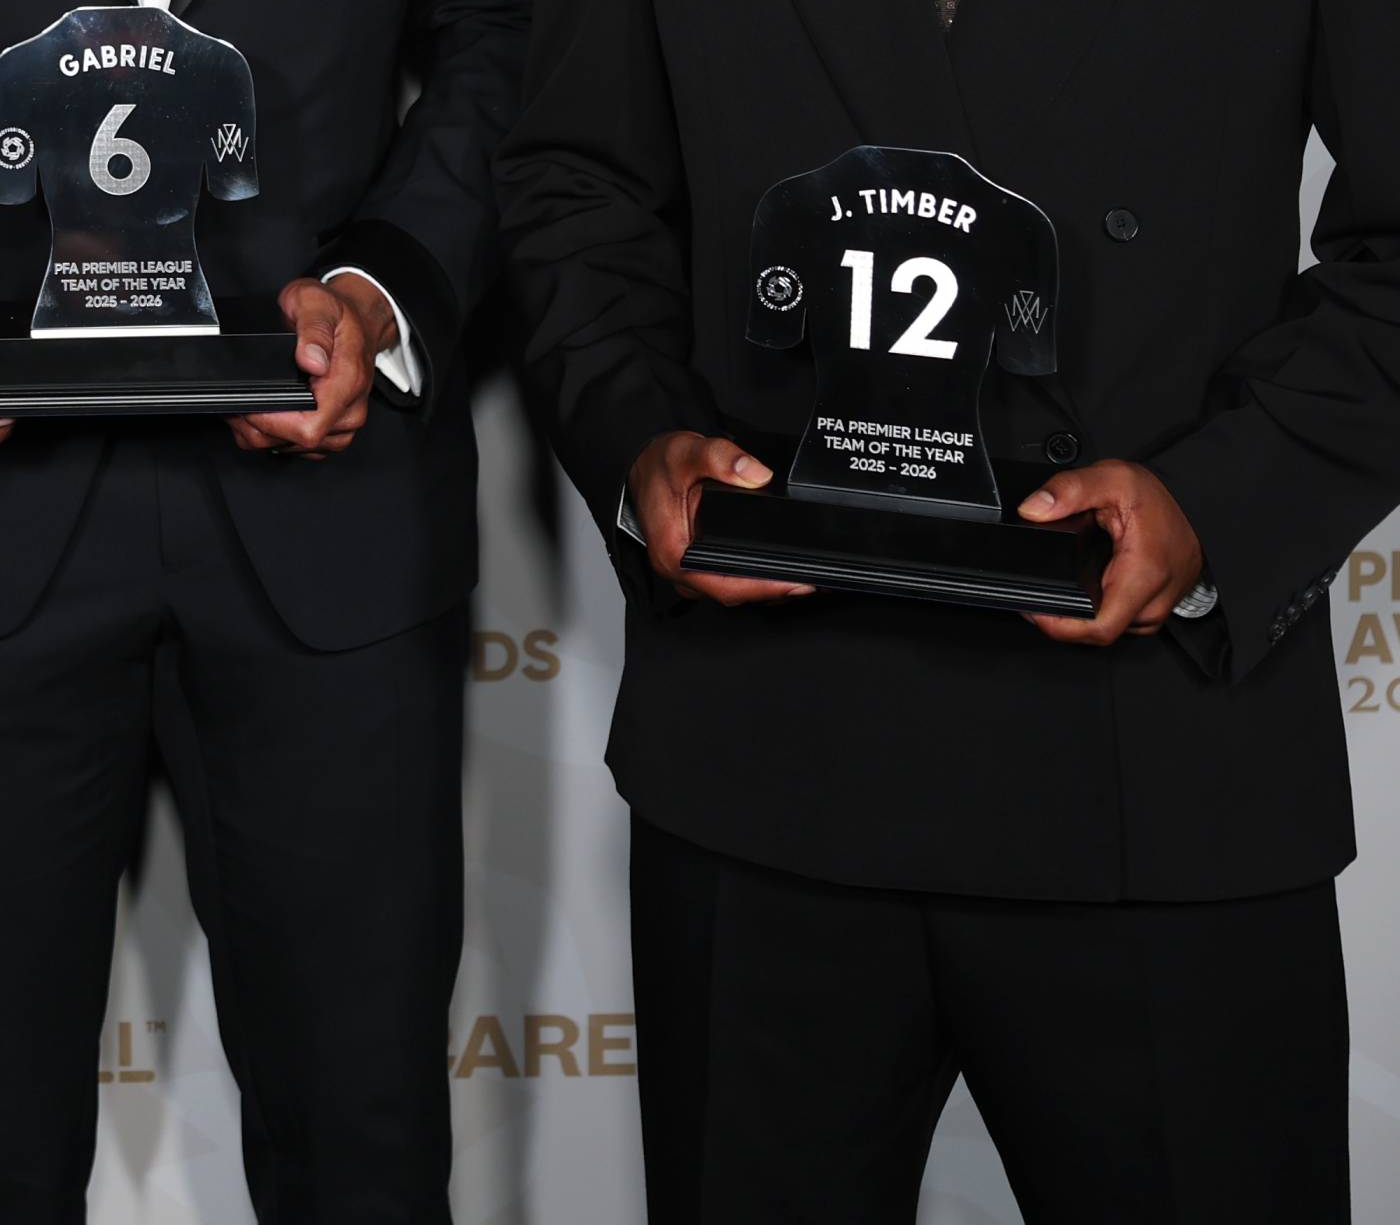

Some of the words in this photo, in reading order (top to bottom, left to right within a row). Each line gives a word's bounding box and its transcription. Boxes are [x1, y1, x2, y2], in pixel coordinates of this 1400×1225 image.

[59, 44, 176, 77] GABRIEL
[89, 104, 151, 196] 6
[830, 195, 853, 222] J.
[859, 189, 977, 233] TIMBER
[54, 262, 79, 275] PFA
[82, 261, 137, 275] PREMIER
[141, 260, 192, 274] LEAGUE
[61, 279, 98, 291] TEAM
[101, 279, 120, 291] OF
[123, 278, 148, 290] THE
[151, 277, 186, 290] YEAR
[85, 295, 117, 308] 2025
[130, 295, 163, 307] 2026
[840, 249, 959, 360] 12
[817, 417, 845, 433] PFA
[848, 420, 911, 440] PREMIER
[915, 428, 973, 447] LEAGUE
[824, 435, 865, 453] TEAM
[868, 440, 890, 455] OF
[893, 443, 922, 459] THE
[925, 446, 964, 464] YEAR
[849, 457, 886, 473] 2025
[900, 462, 937, 479] 2026
[449, 1013, 637, 1078] ARE
